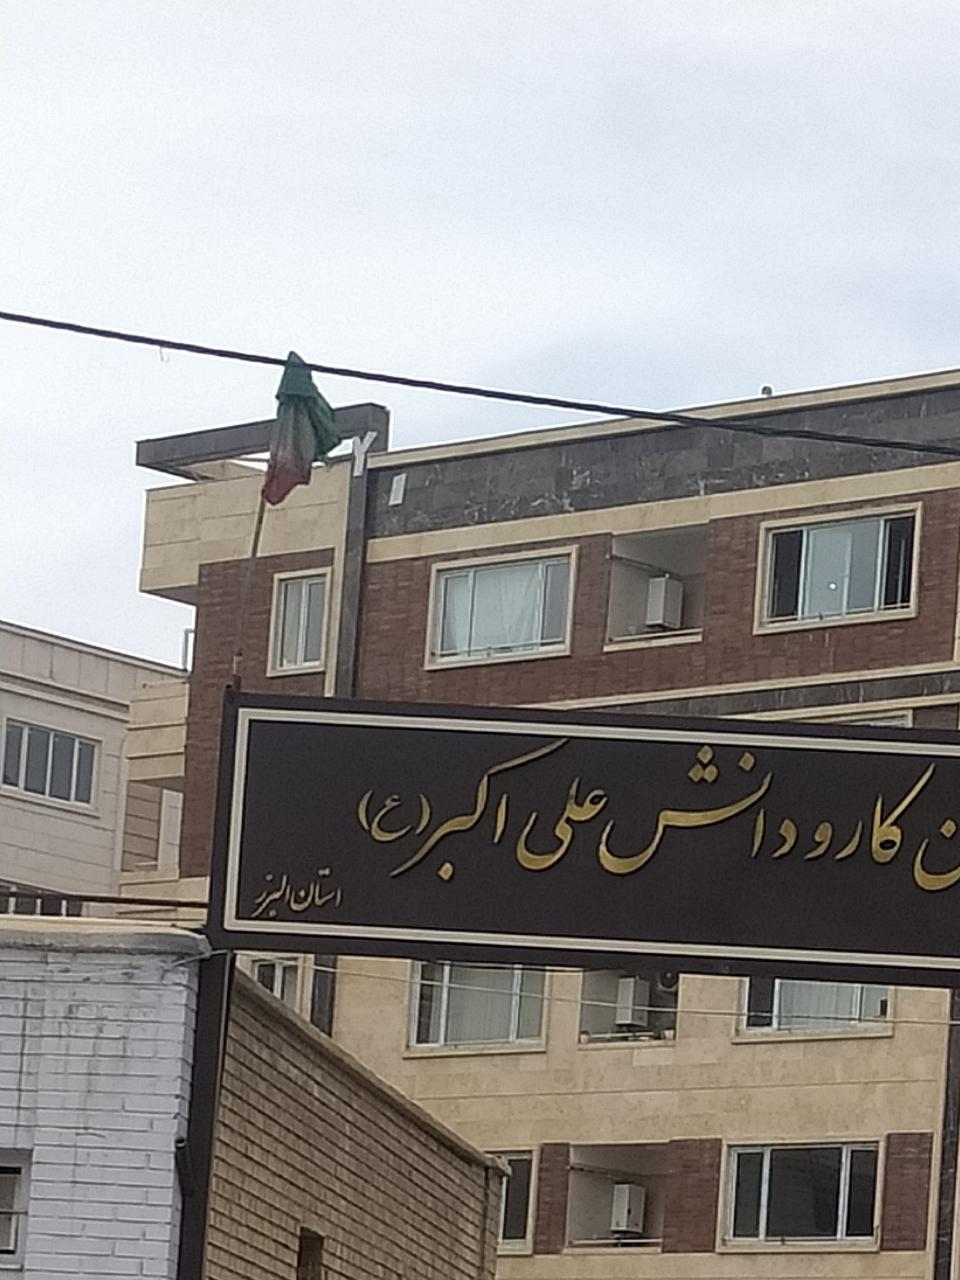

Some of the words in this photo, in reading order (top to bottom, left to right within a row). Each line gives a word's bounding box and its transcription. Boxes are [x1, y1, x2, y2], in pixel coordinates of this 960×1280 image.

[357, 789, 431, 843] (ع)
[388, 737, 570, 882] اکبر
[515, 775, 608, 871] علی
[251, 873, 291, 918] البرز
[289, 867, 342, 912] استان
